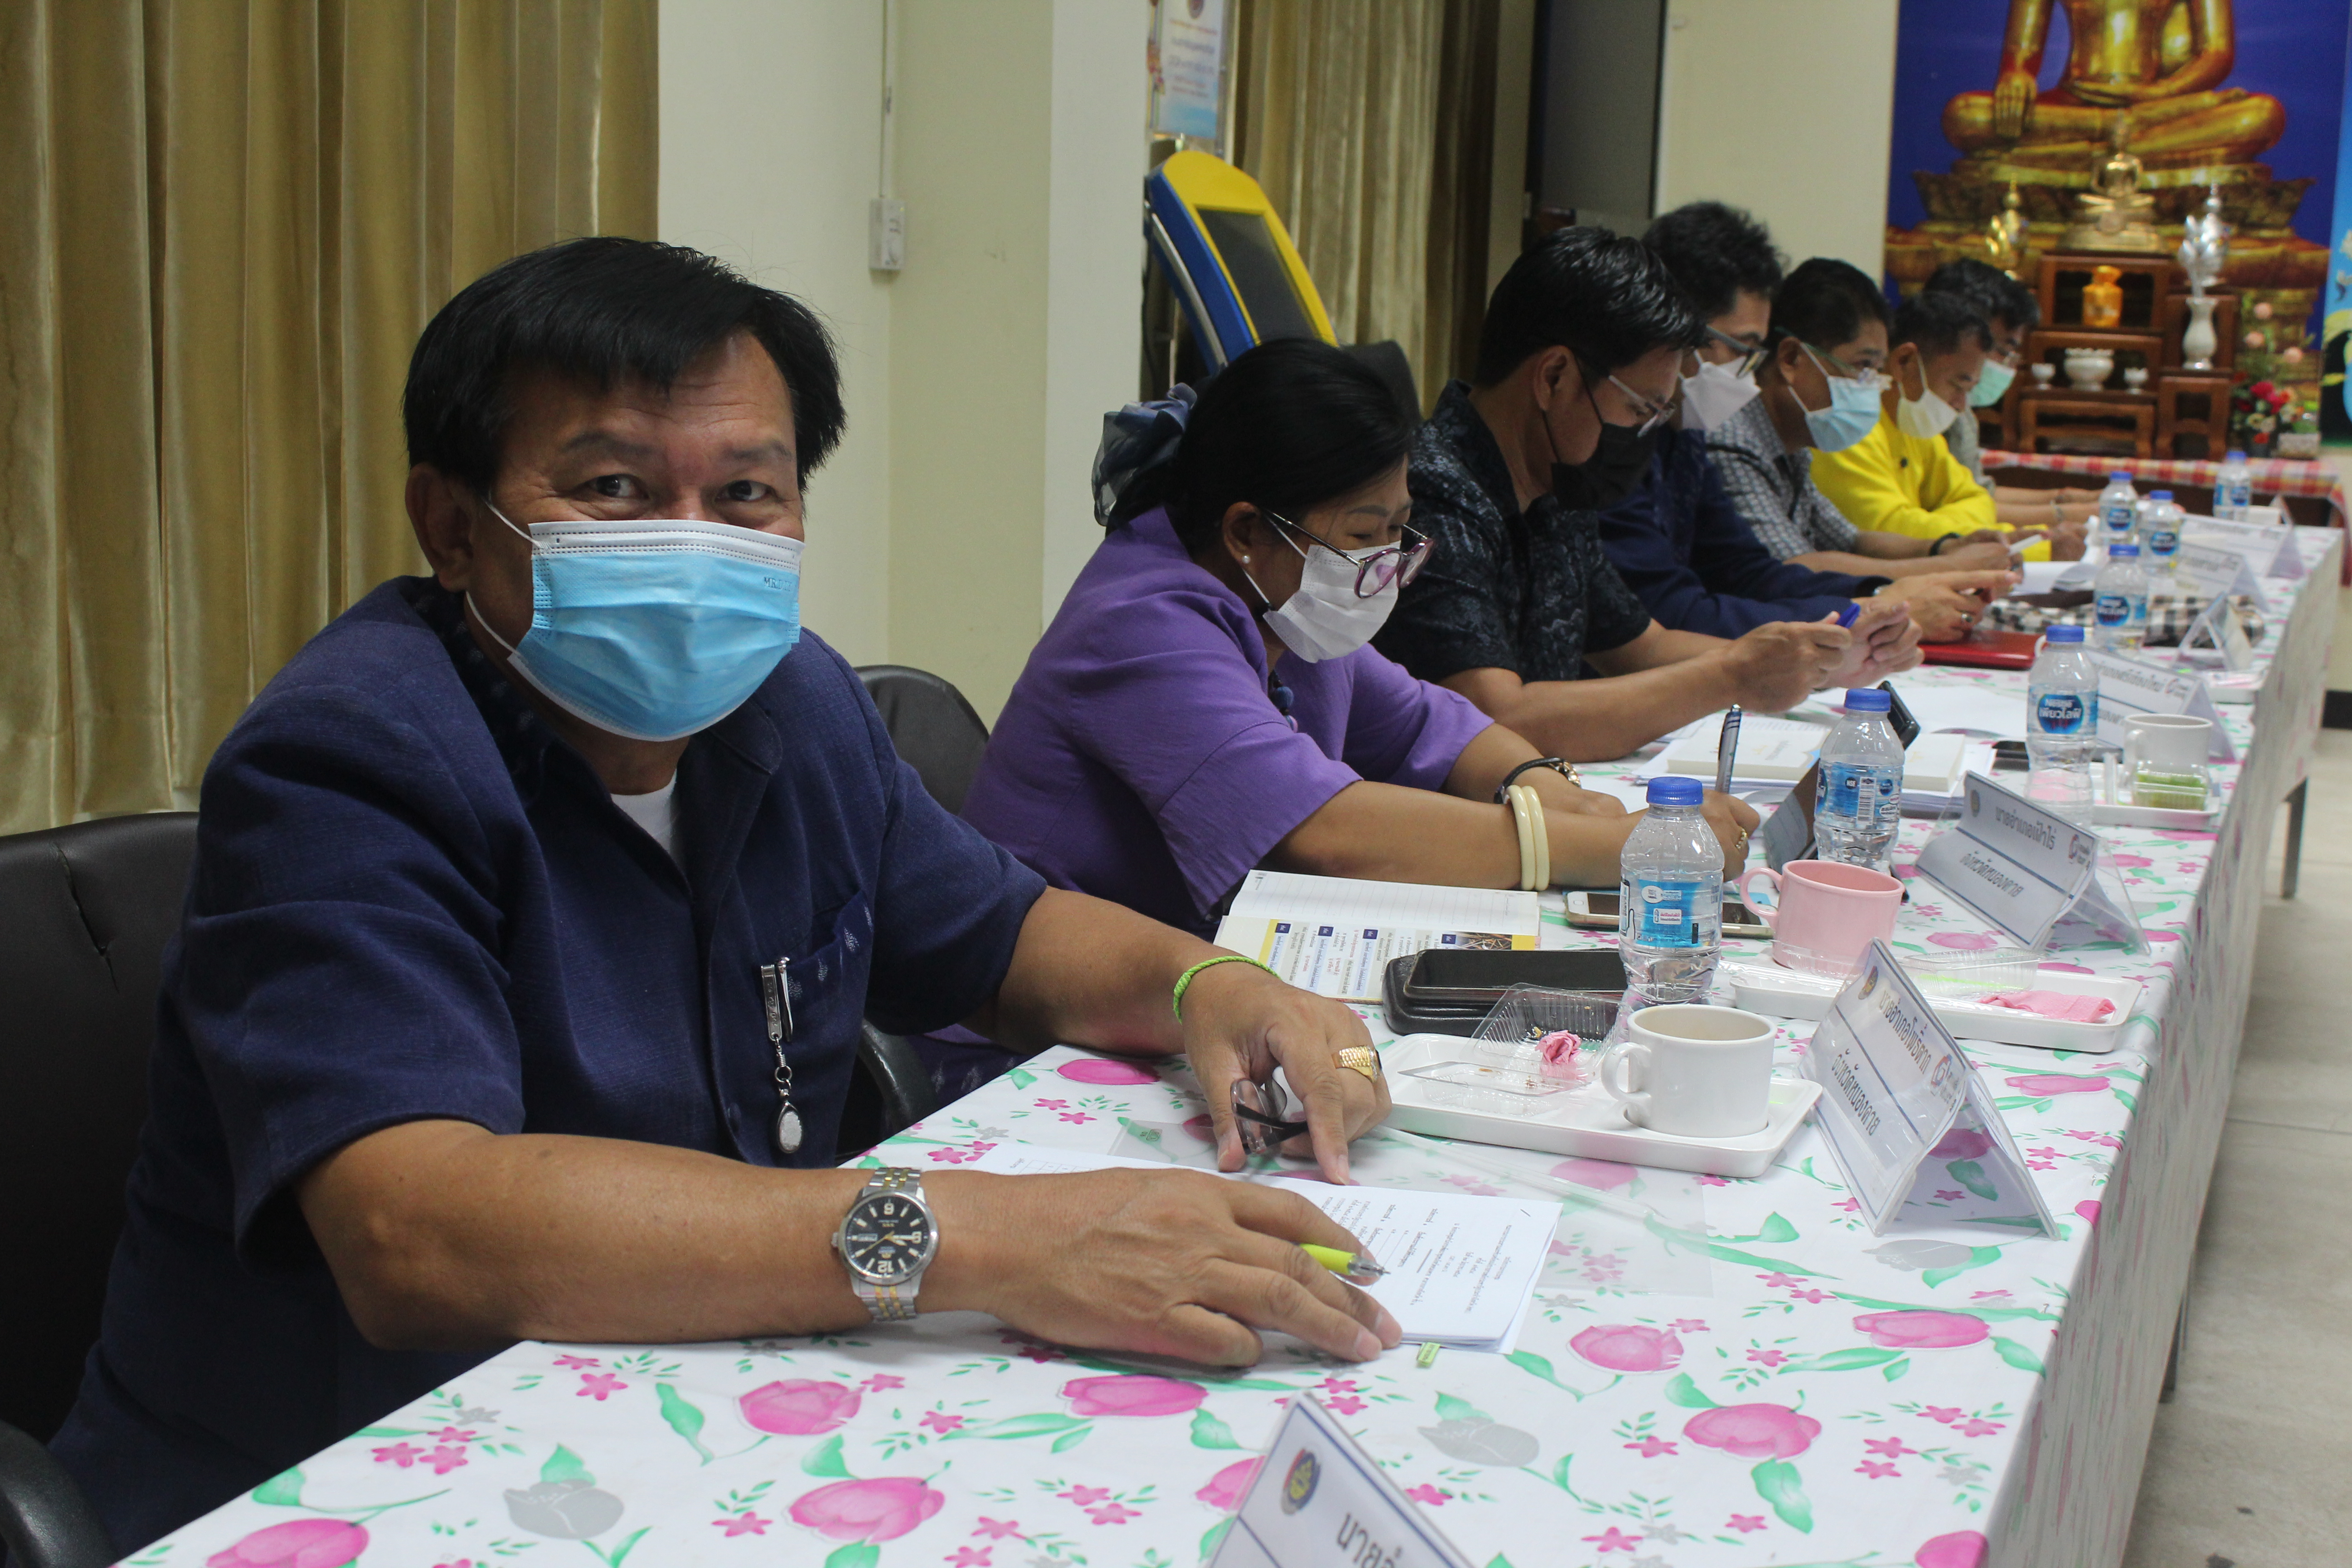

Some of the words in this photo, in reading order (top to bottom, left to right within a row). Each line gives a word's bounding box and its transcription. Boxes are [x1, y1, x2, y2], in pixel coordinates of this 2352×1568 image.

[1831, 1049, 1881, 1136] จังหวัดหนองคาย
